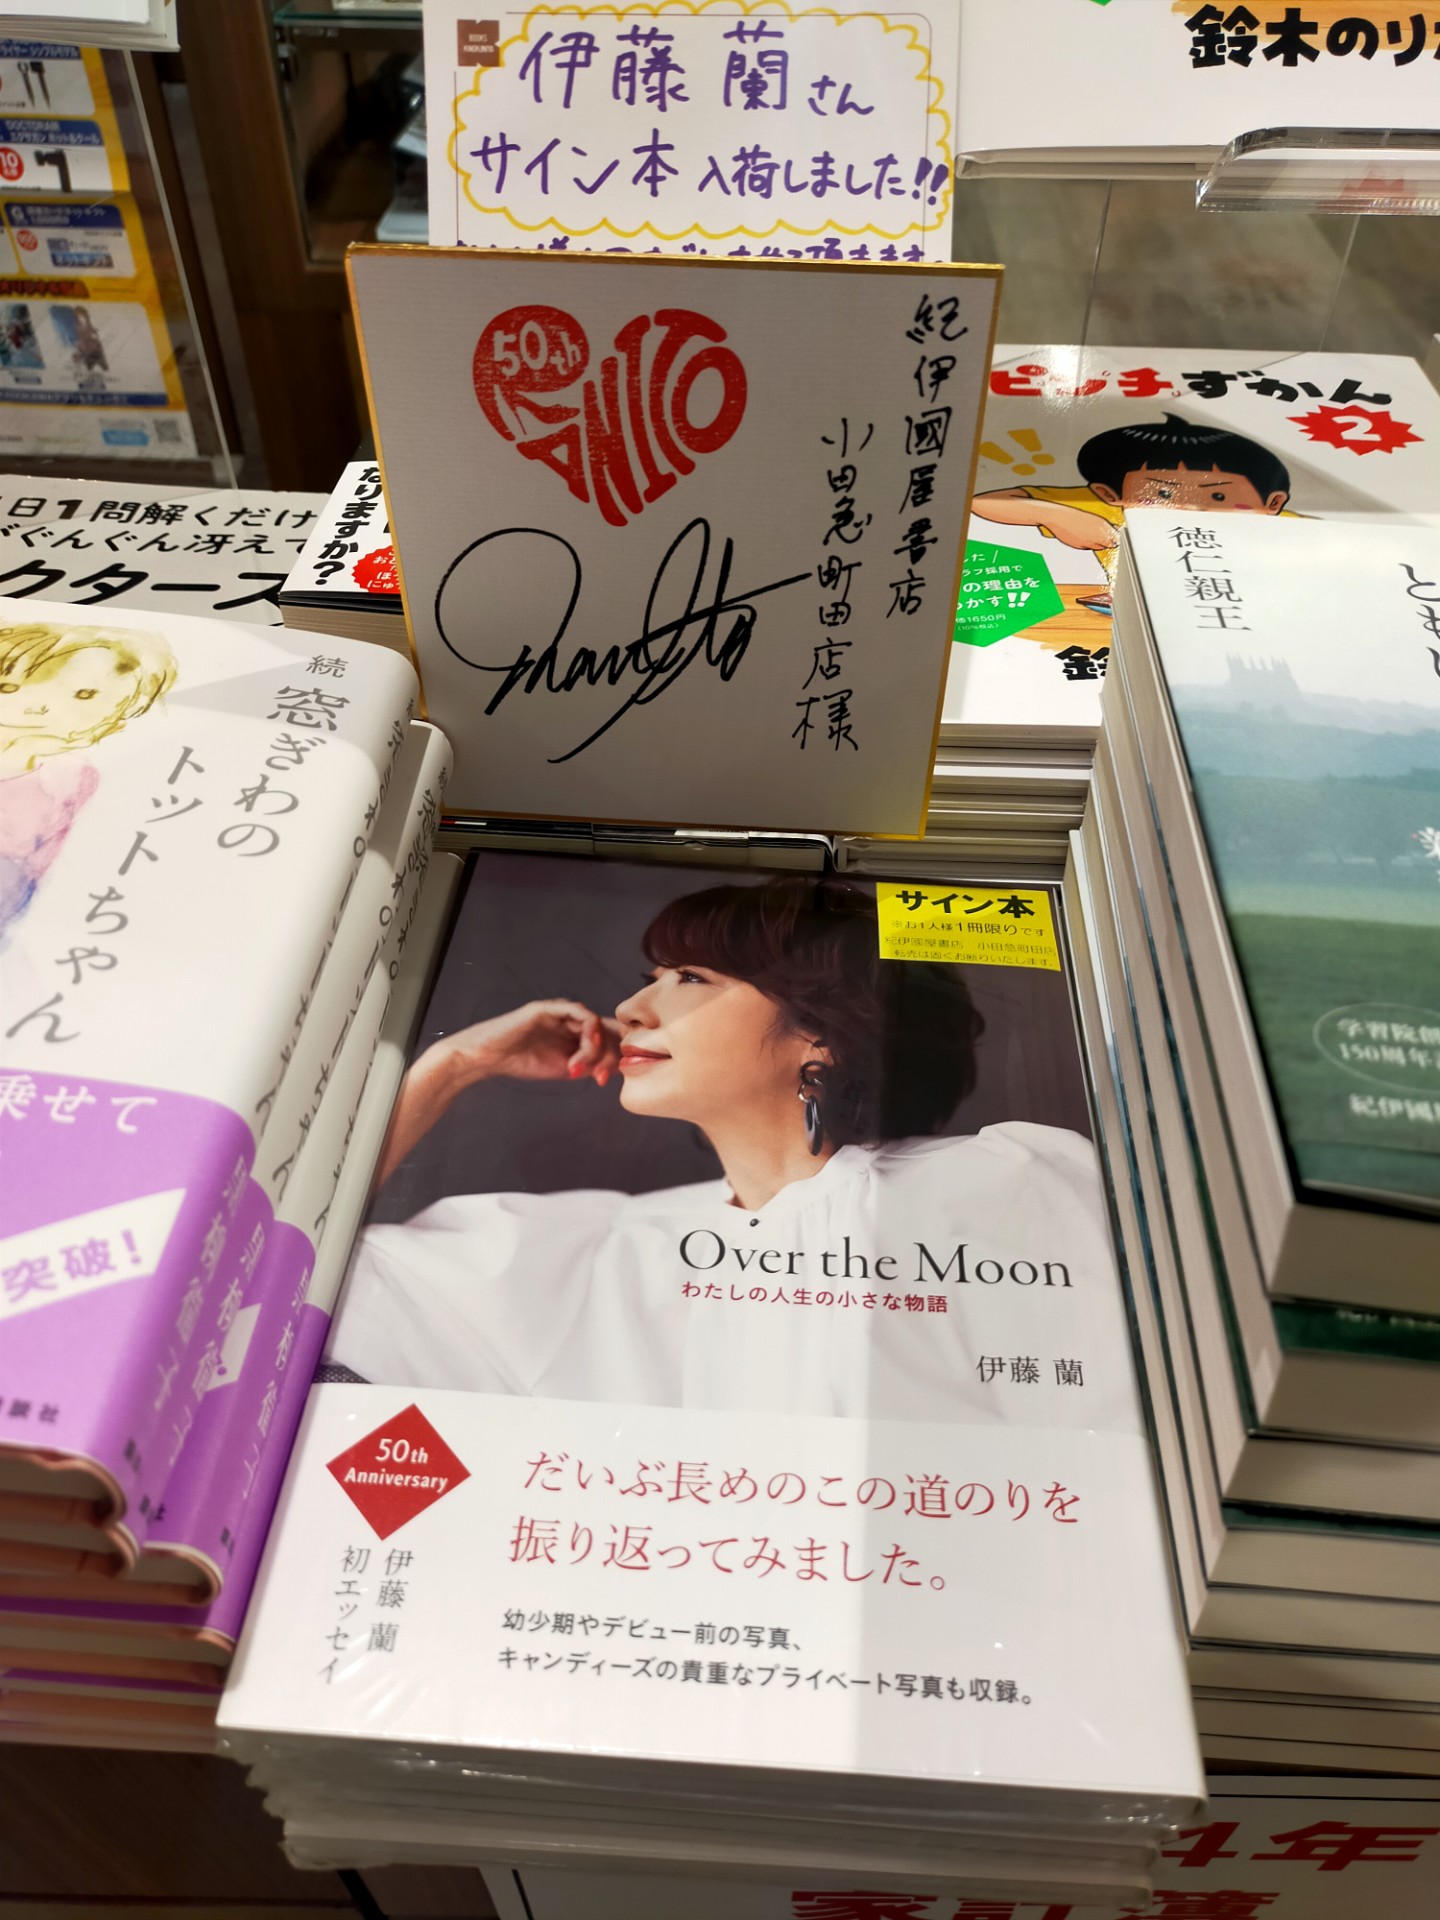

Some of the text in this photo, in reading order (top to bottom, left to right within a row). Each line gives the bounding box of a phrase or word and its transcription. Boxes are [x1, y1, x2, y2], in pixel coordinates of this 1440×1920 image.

[1184, 3, 1440, 69] 鈴木のり
[470, 127, 679, 197] サイン本
[493, 318, 582, 377] 50th
[1331, 415, 1383, 443] 2
[0, 495, 319, 529] 日1問解くだけ
[1167, 526, 1253, 632] 徳仁親王
[6, 746, 206, 1044] トットちゃん
[895, 890, 1036, 919] サイン本
[679, 1229, 1074, 1288] Over the Moon
[681, 1281, 949, 1314] わたしの人生の小さな物語
[976, 1355, 1085, 1387] 伊藤 蘭
[343, 1467, 449, 1494] Anniversary
[374, 1437, 429, 1465] 50th
[524, 1450, 1082, 1523] だいぶ長めのこの道のりを
[376, 1548, 414, 1609] 伊藤
[507, 1515, 947, 1592] 振り返ってみました。
[318, 1545, 371, 1685] 初エッセイ
[501, 1608, 803, 1653] 幼少期やデビュー前の写真、
[496, 1647, 1033, 1706] キャンディーズの貴重なプライベート写真も収録。
